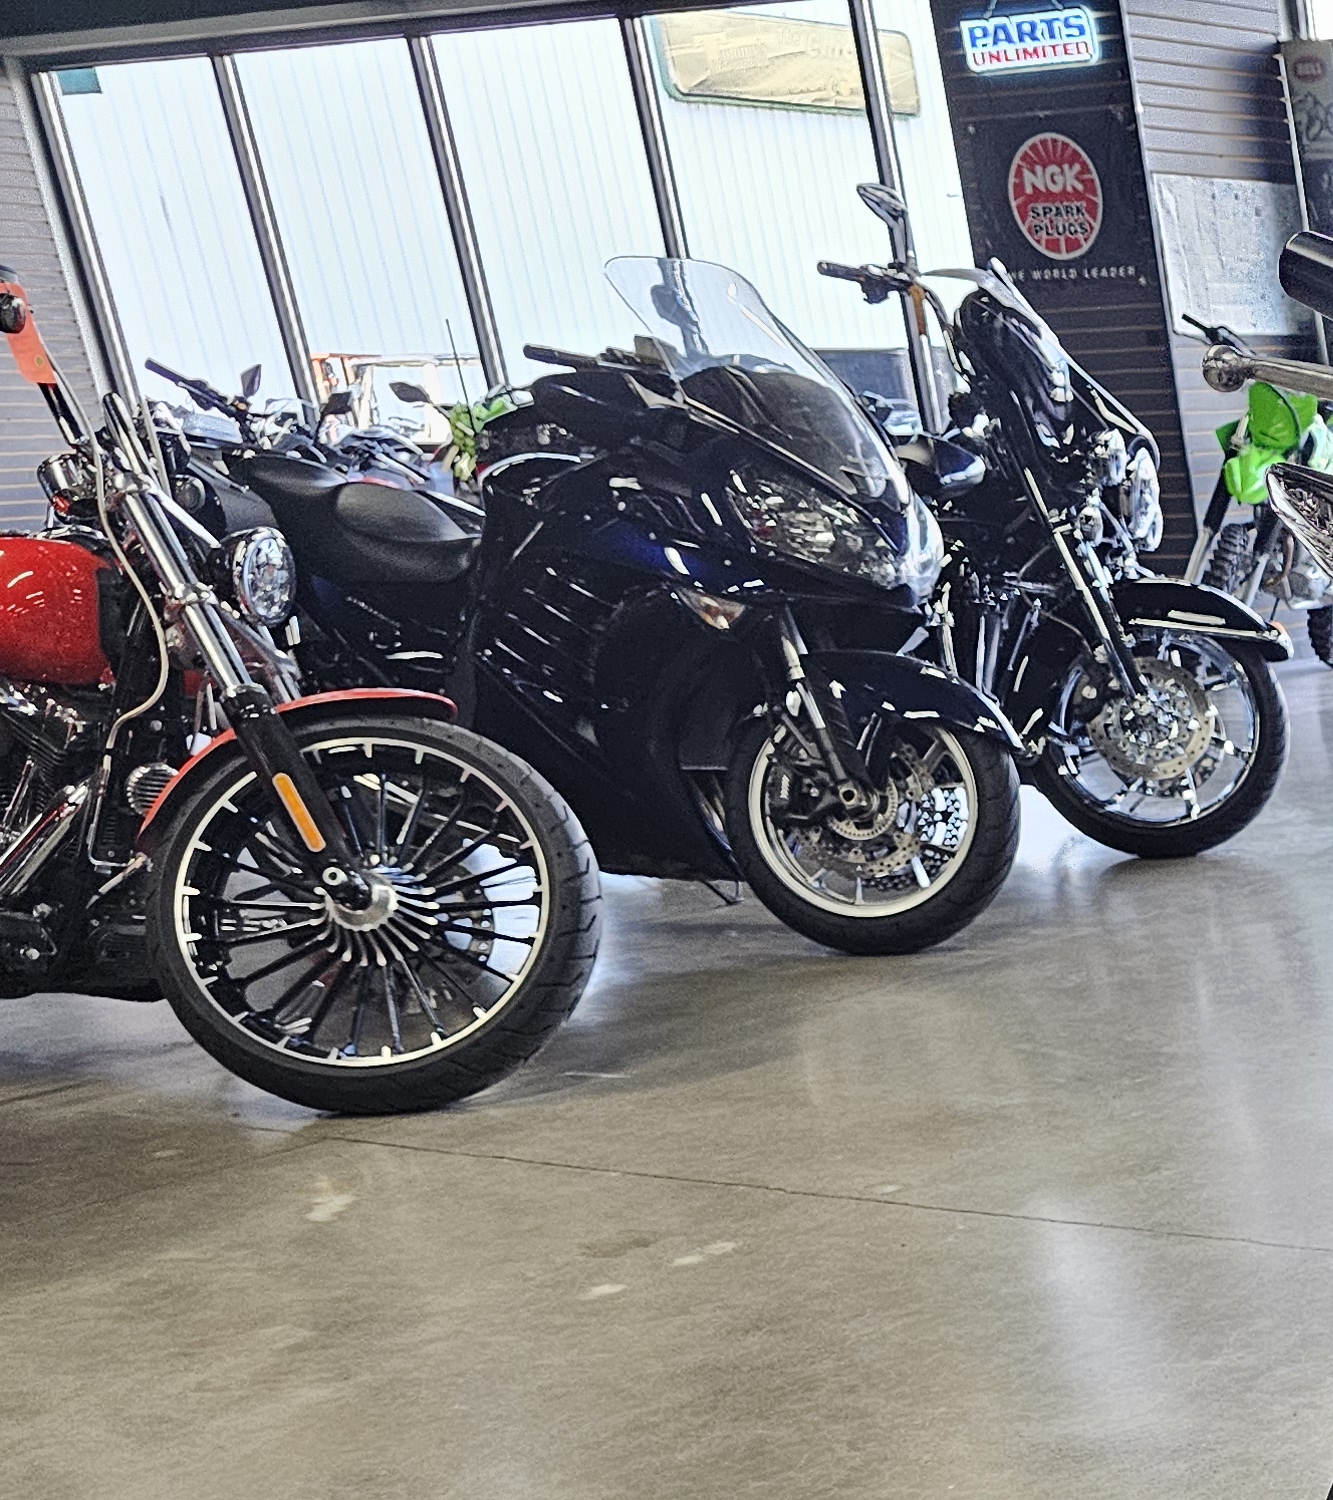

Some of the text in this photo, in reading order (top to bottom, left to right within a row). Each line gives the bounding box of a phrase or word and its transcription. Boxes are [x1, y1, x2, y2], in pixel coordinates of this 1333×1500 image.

[968, 15, 1086, 49] PARTS
[972, 41, 1092, 66] UNLIMITED
[1022, 163, 1084, 194] NGK
[1031, 204, 1086, 219] SPARK
[1034, 222, 1088, 236] PLUGS
[1031, 268, 1078, 281] WORLD
[1082, 265, 1135, 279] LEADER
